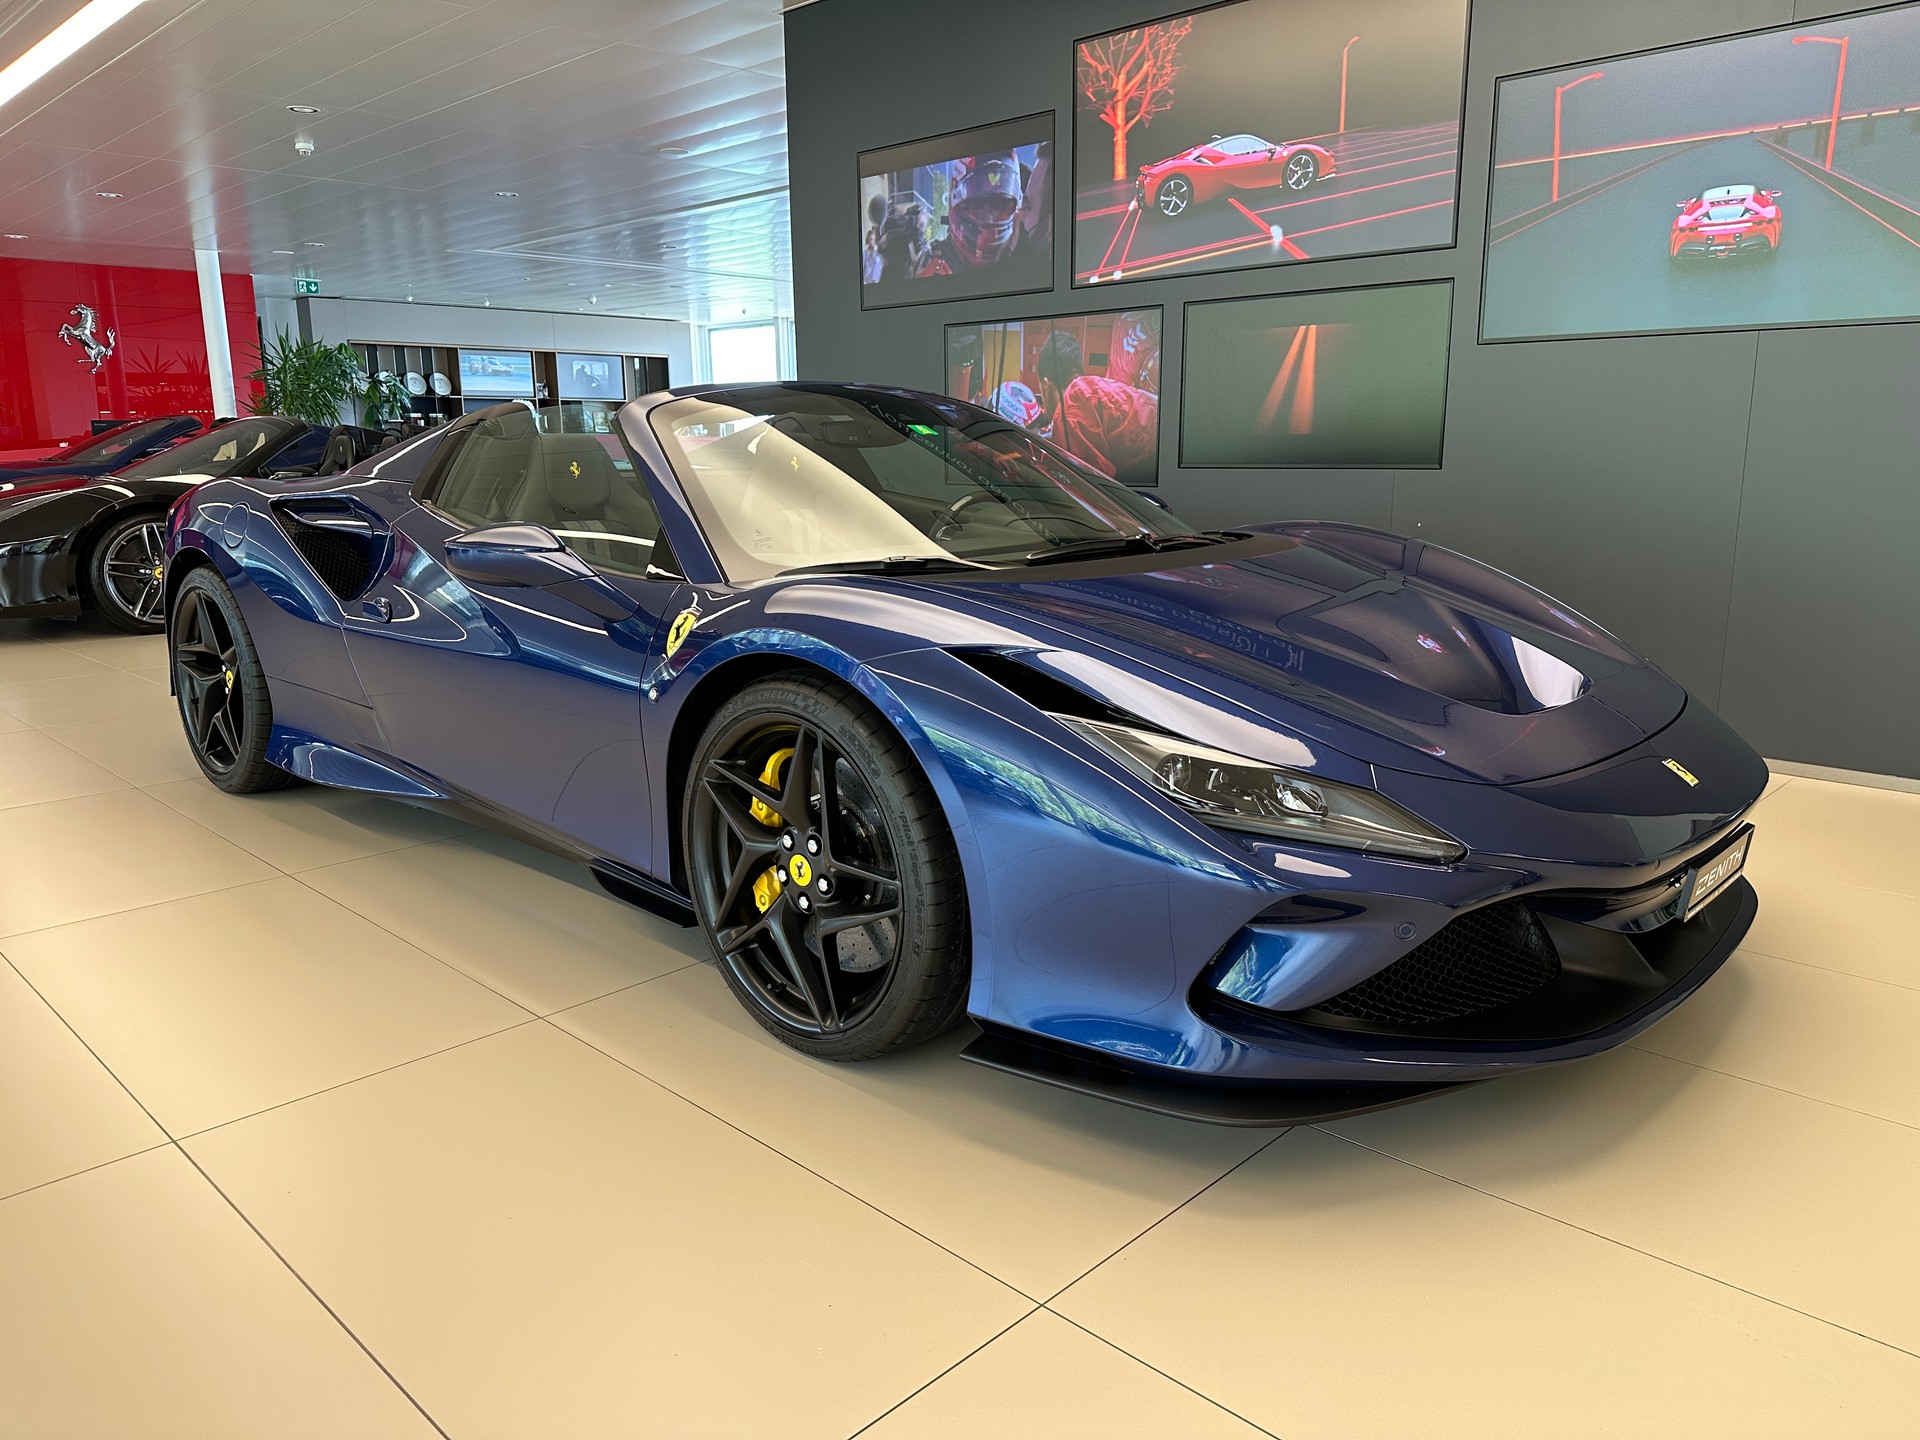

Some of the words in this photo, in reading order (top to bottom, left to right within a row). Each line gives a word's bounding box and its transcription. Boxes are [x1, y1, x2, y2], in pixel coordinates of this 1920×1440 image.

[744, 690, 797, 704] MICHELIN
[898, 813, 915, 847] Pilot
[909, 852, 924, 892] Super
[1695, 845, 1746, 897] ZENITH
[915, 897, 925, 936] Sport
